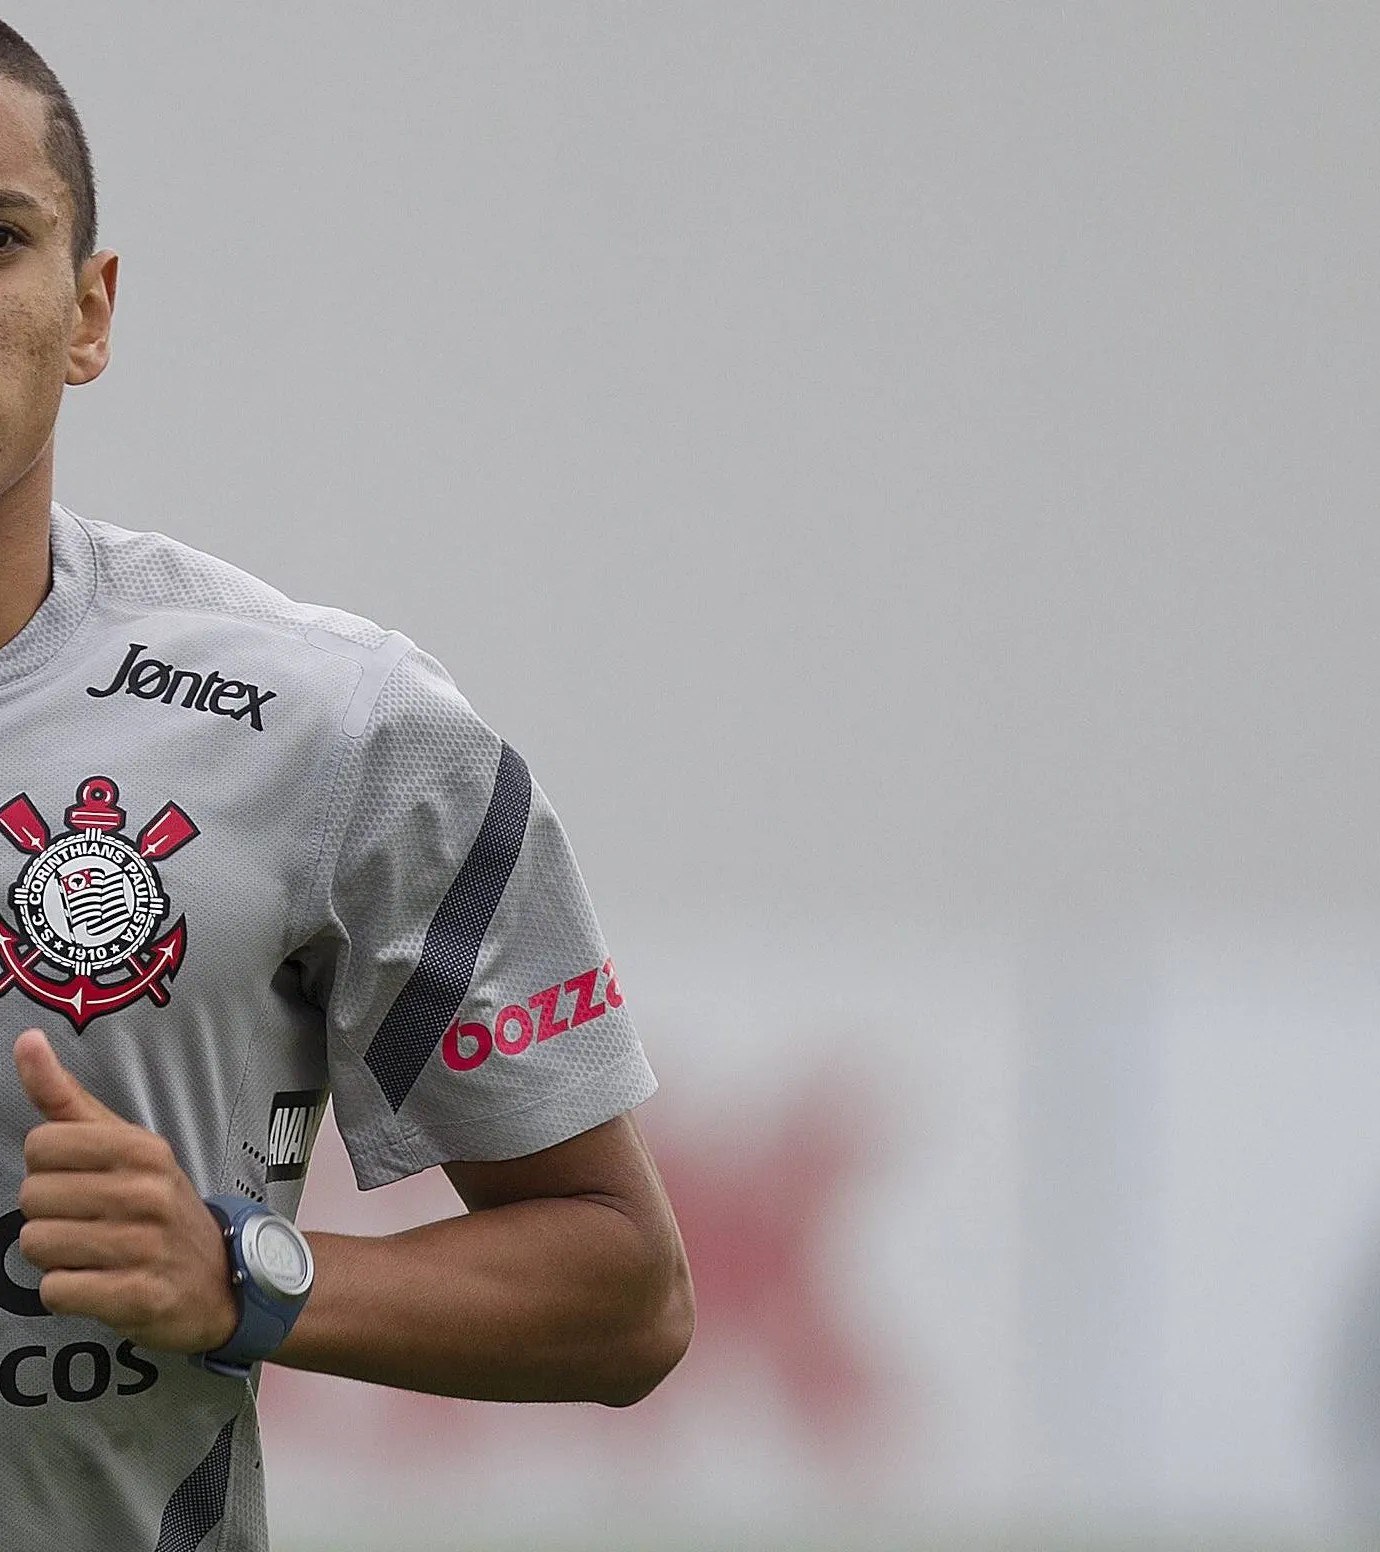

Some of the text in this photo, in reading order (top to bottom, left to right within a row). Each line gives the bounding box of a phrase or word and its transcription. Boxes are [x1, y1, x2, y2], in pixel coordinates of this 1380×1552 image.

[29, 842, 126, 905] CORINTHIANS
[120, 861, 149, 943] PAULISTA
[67, 946, 107, 961] 1910
